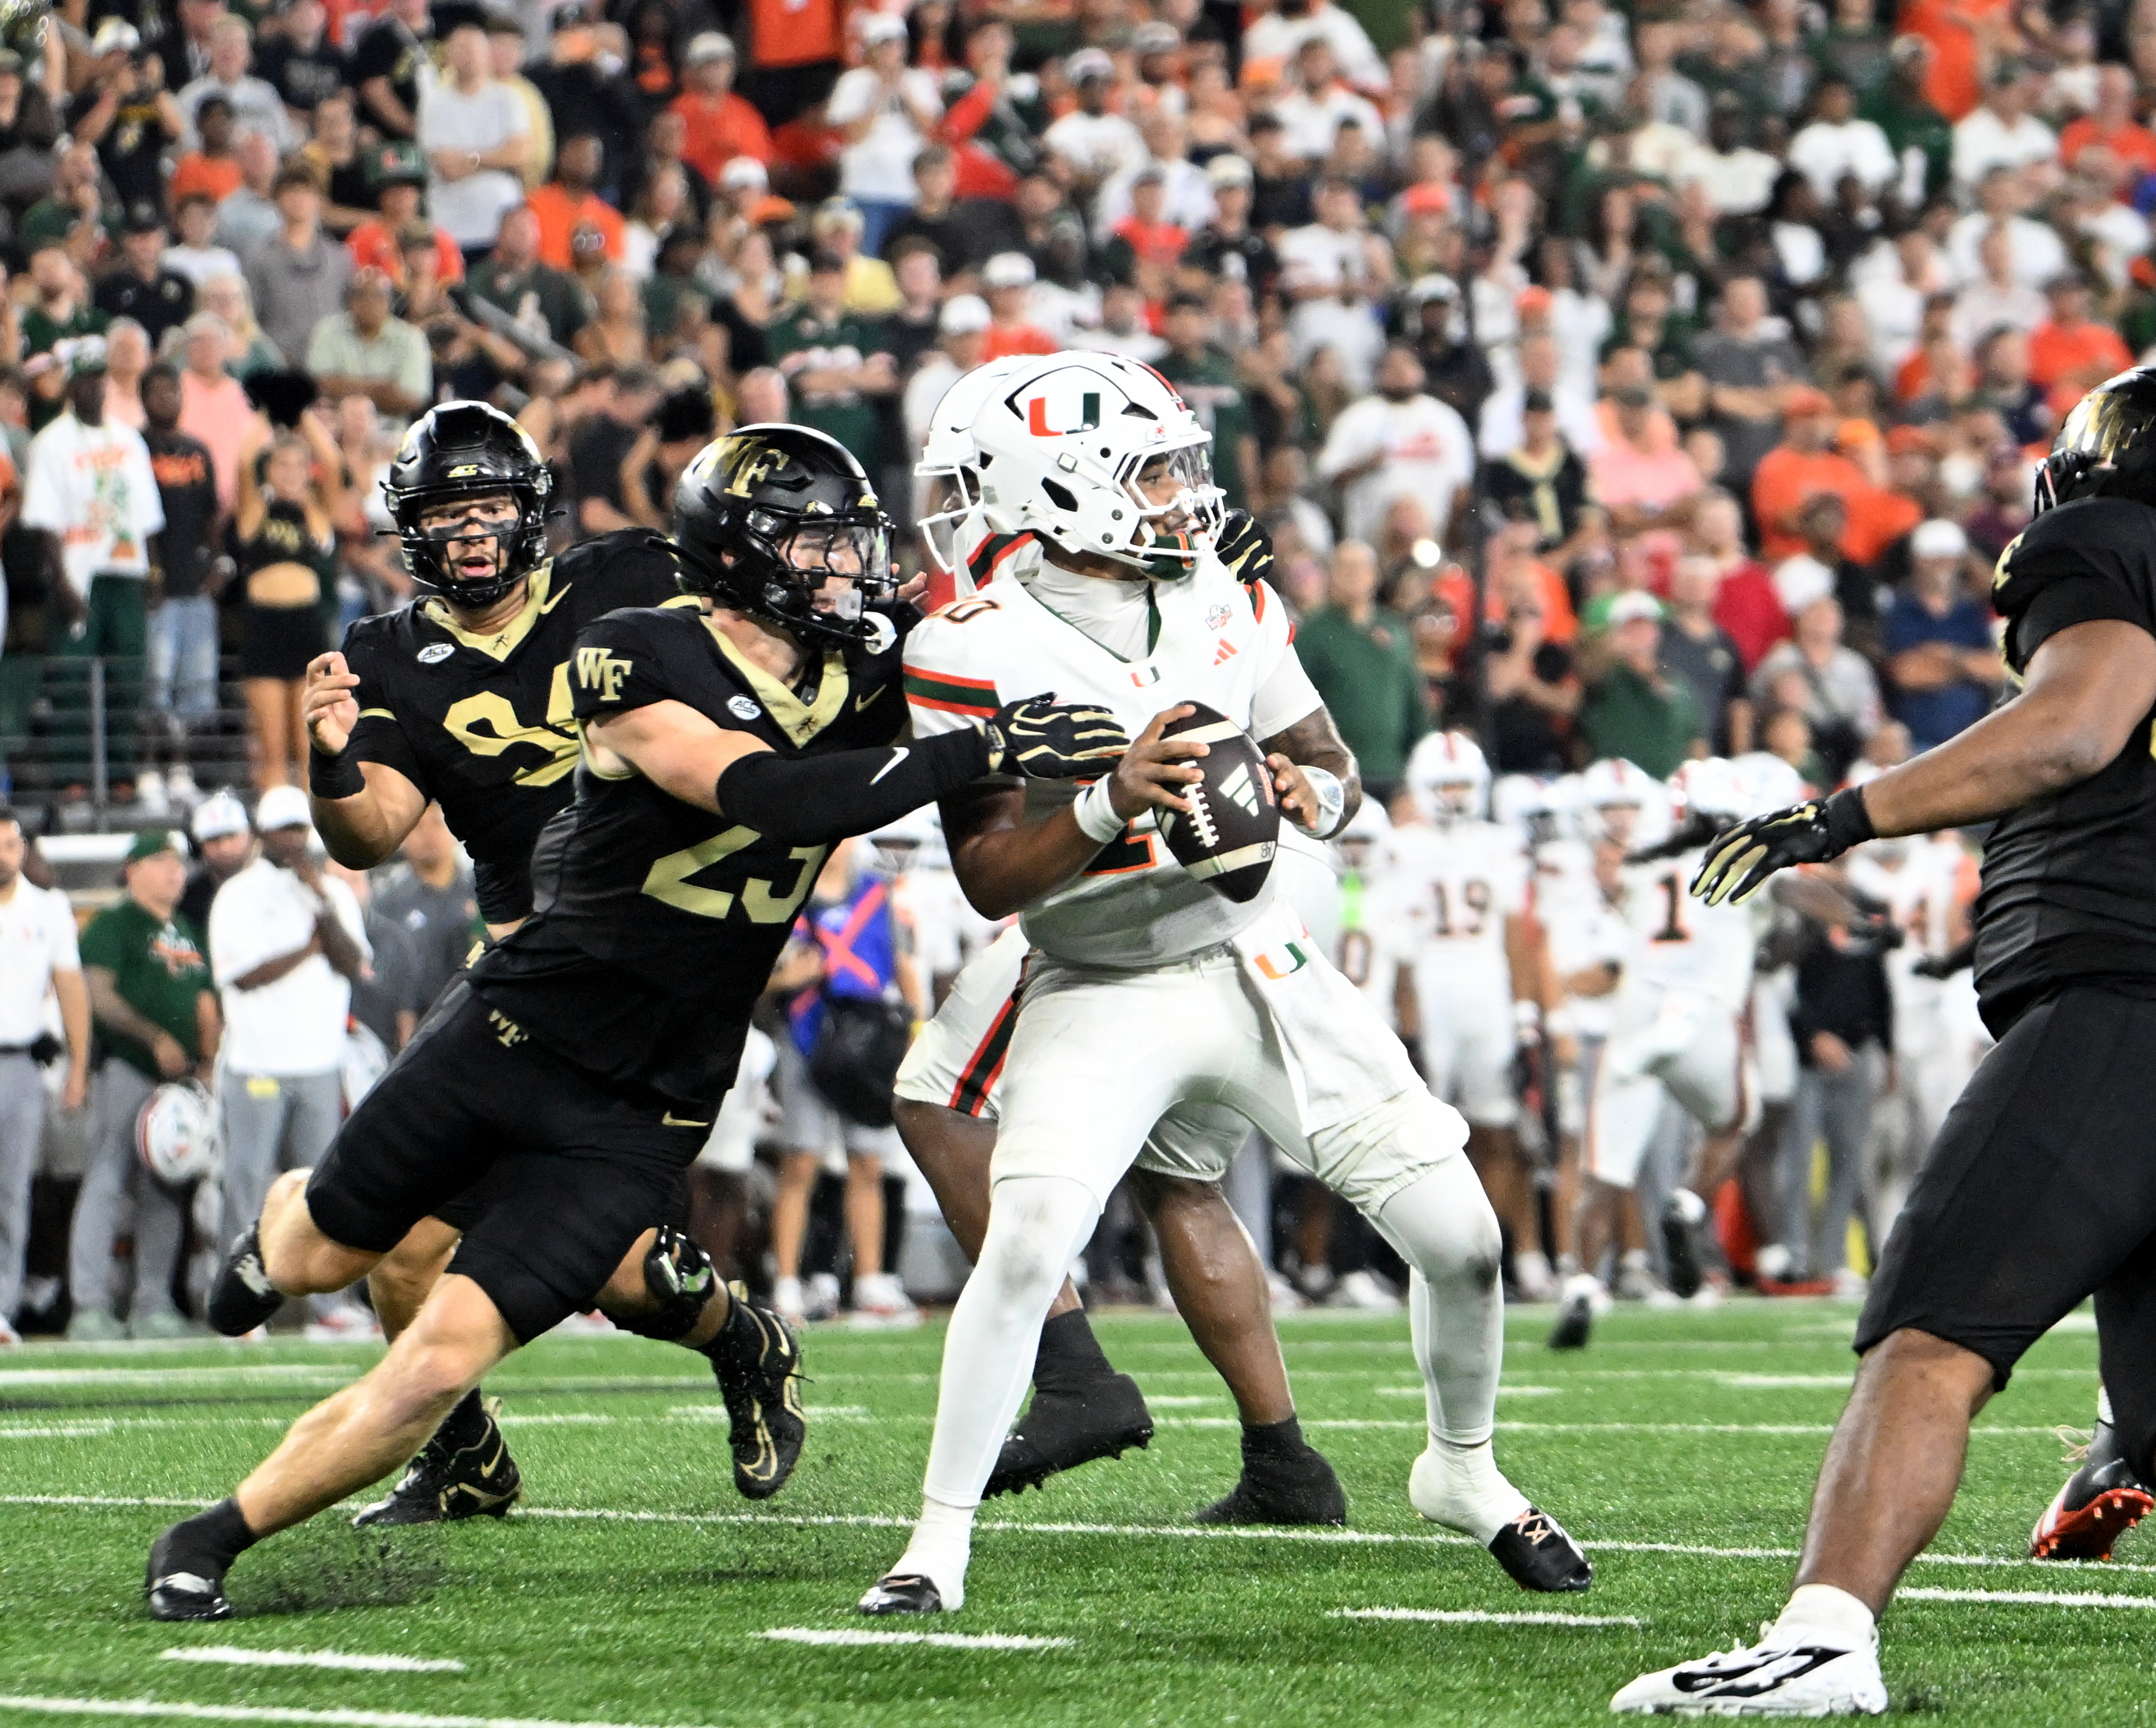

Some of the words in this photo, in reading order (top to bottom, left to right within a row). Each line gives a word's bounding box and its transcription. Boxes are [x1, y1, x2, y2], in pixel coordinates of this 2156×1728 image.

[1029, 392, 1101, 437] U
[694, 435, 791, 499] WF
[422, 644, 449, 660] ACC
[577, 647, 633, 701] WF
[1130, 666, 1161, 687] U
[732, 700, 757, 714] ACC
[1429, 878, 1491, 938] 19
[1649, 871, 1691, 944] 1
[1254, 942, 1307, 980] U
